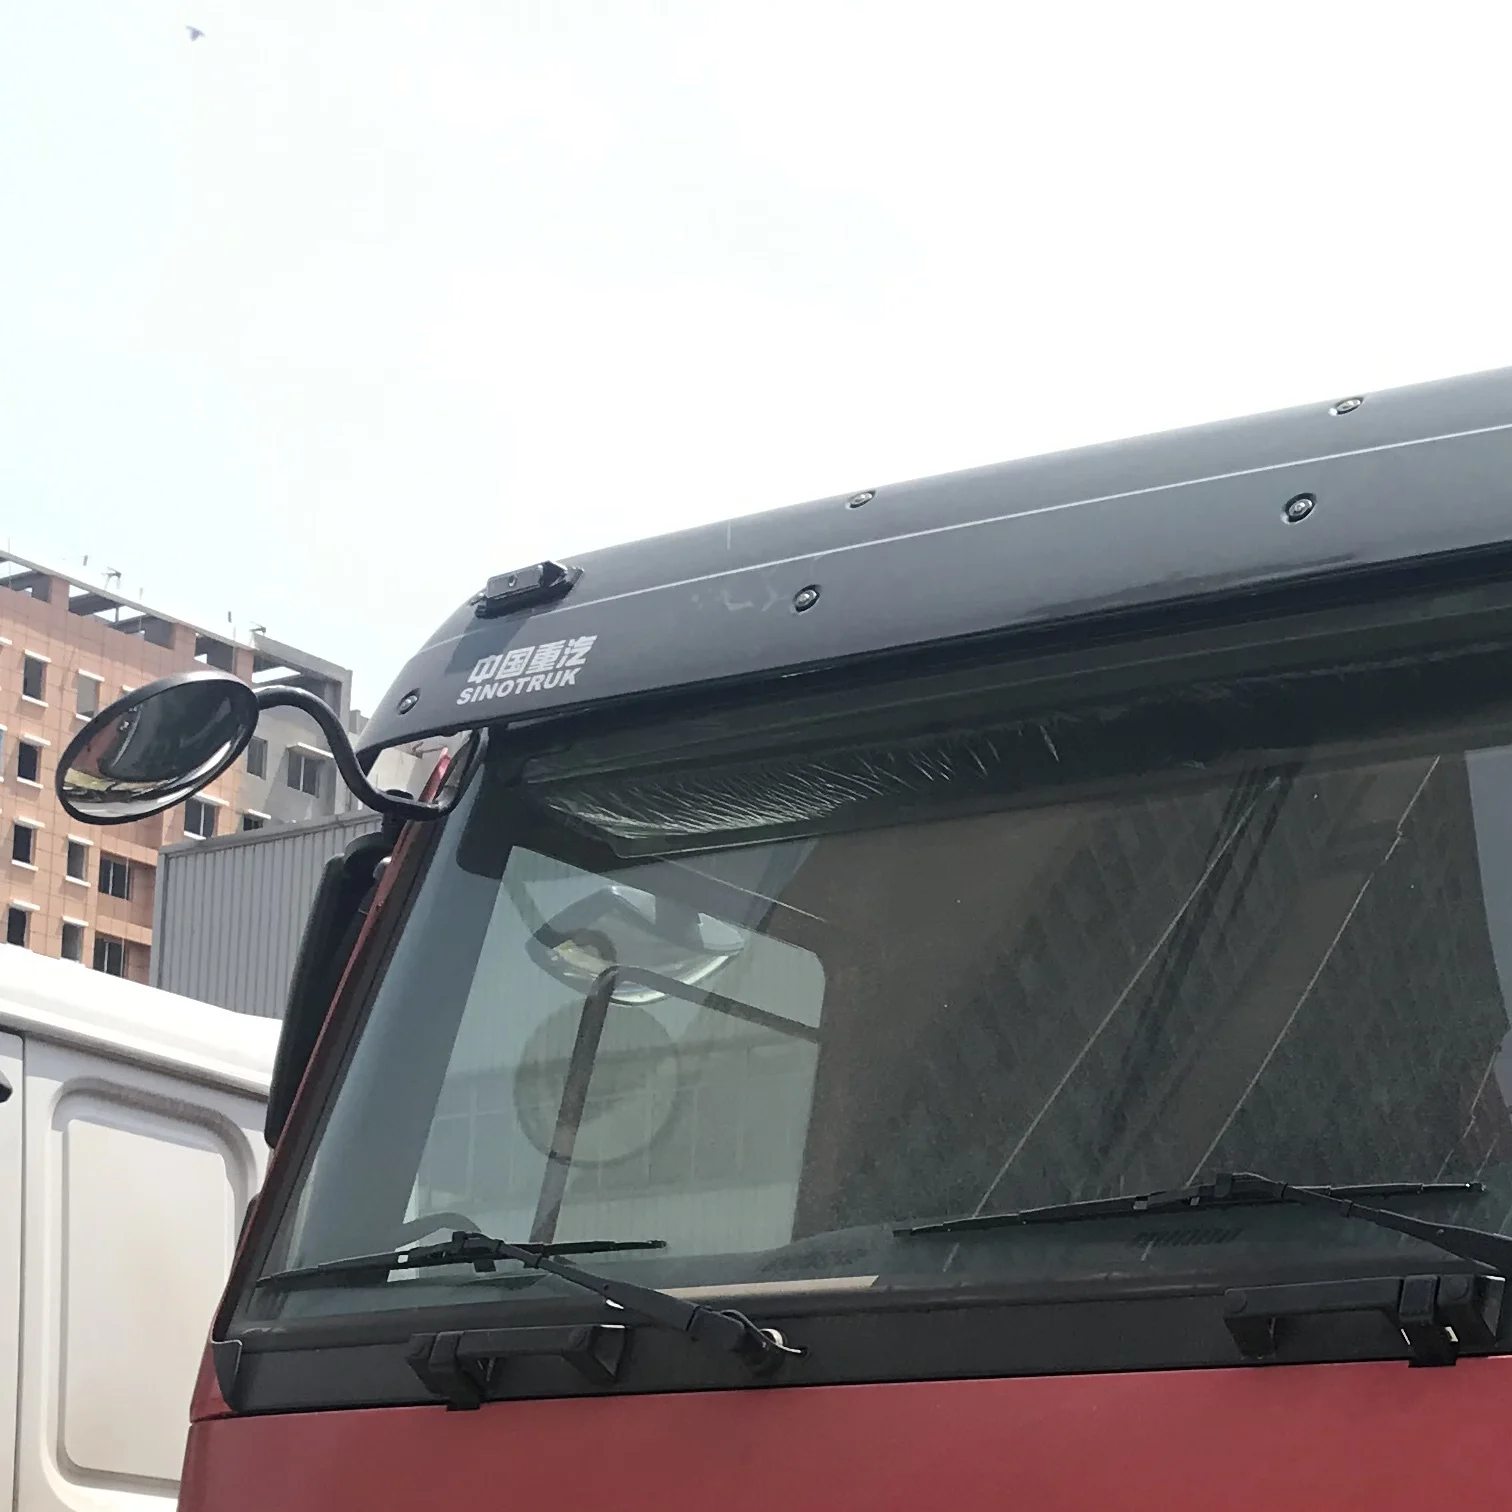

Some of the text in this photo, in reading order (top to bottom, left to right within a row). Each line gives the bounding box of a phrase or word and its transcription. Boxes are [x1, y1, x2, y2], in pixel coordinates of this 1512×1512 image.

[467, 635, 598, 683] 中国重汽
[457, 668, 581, 705] SINOTRUK
